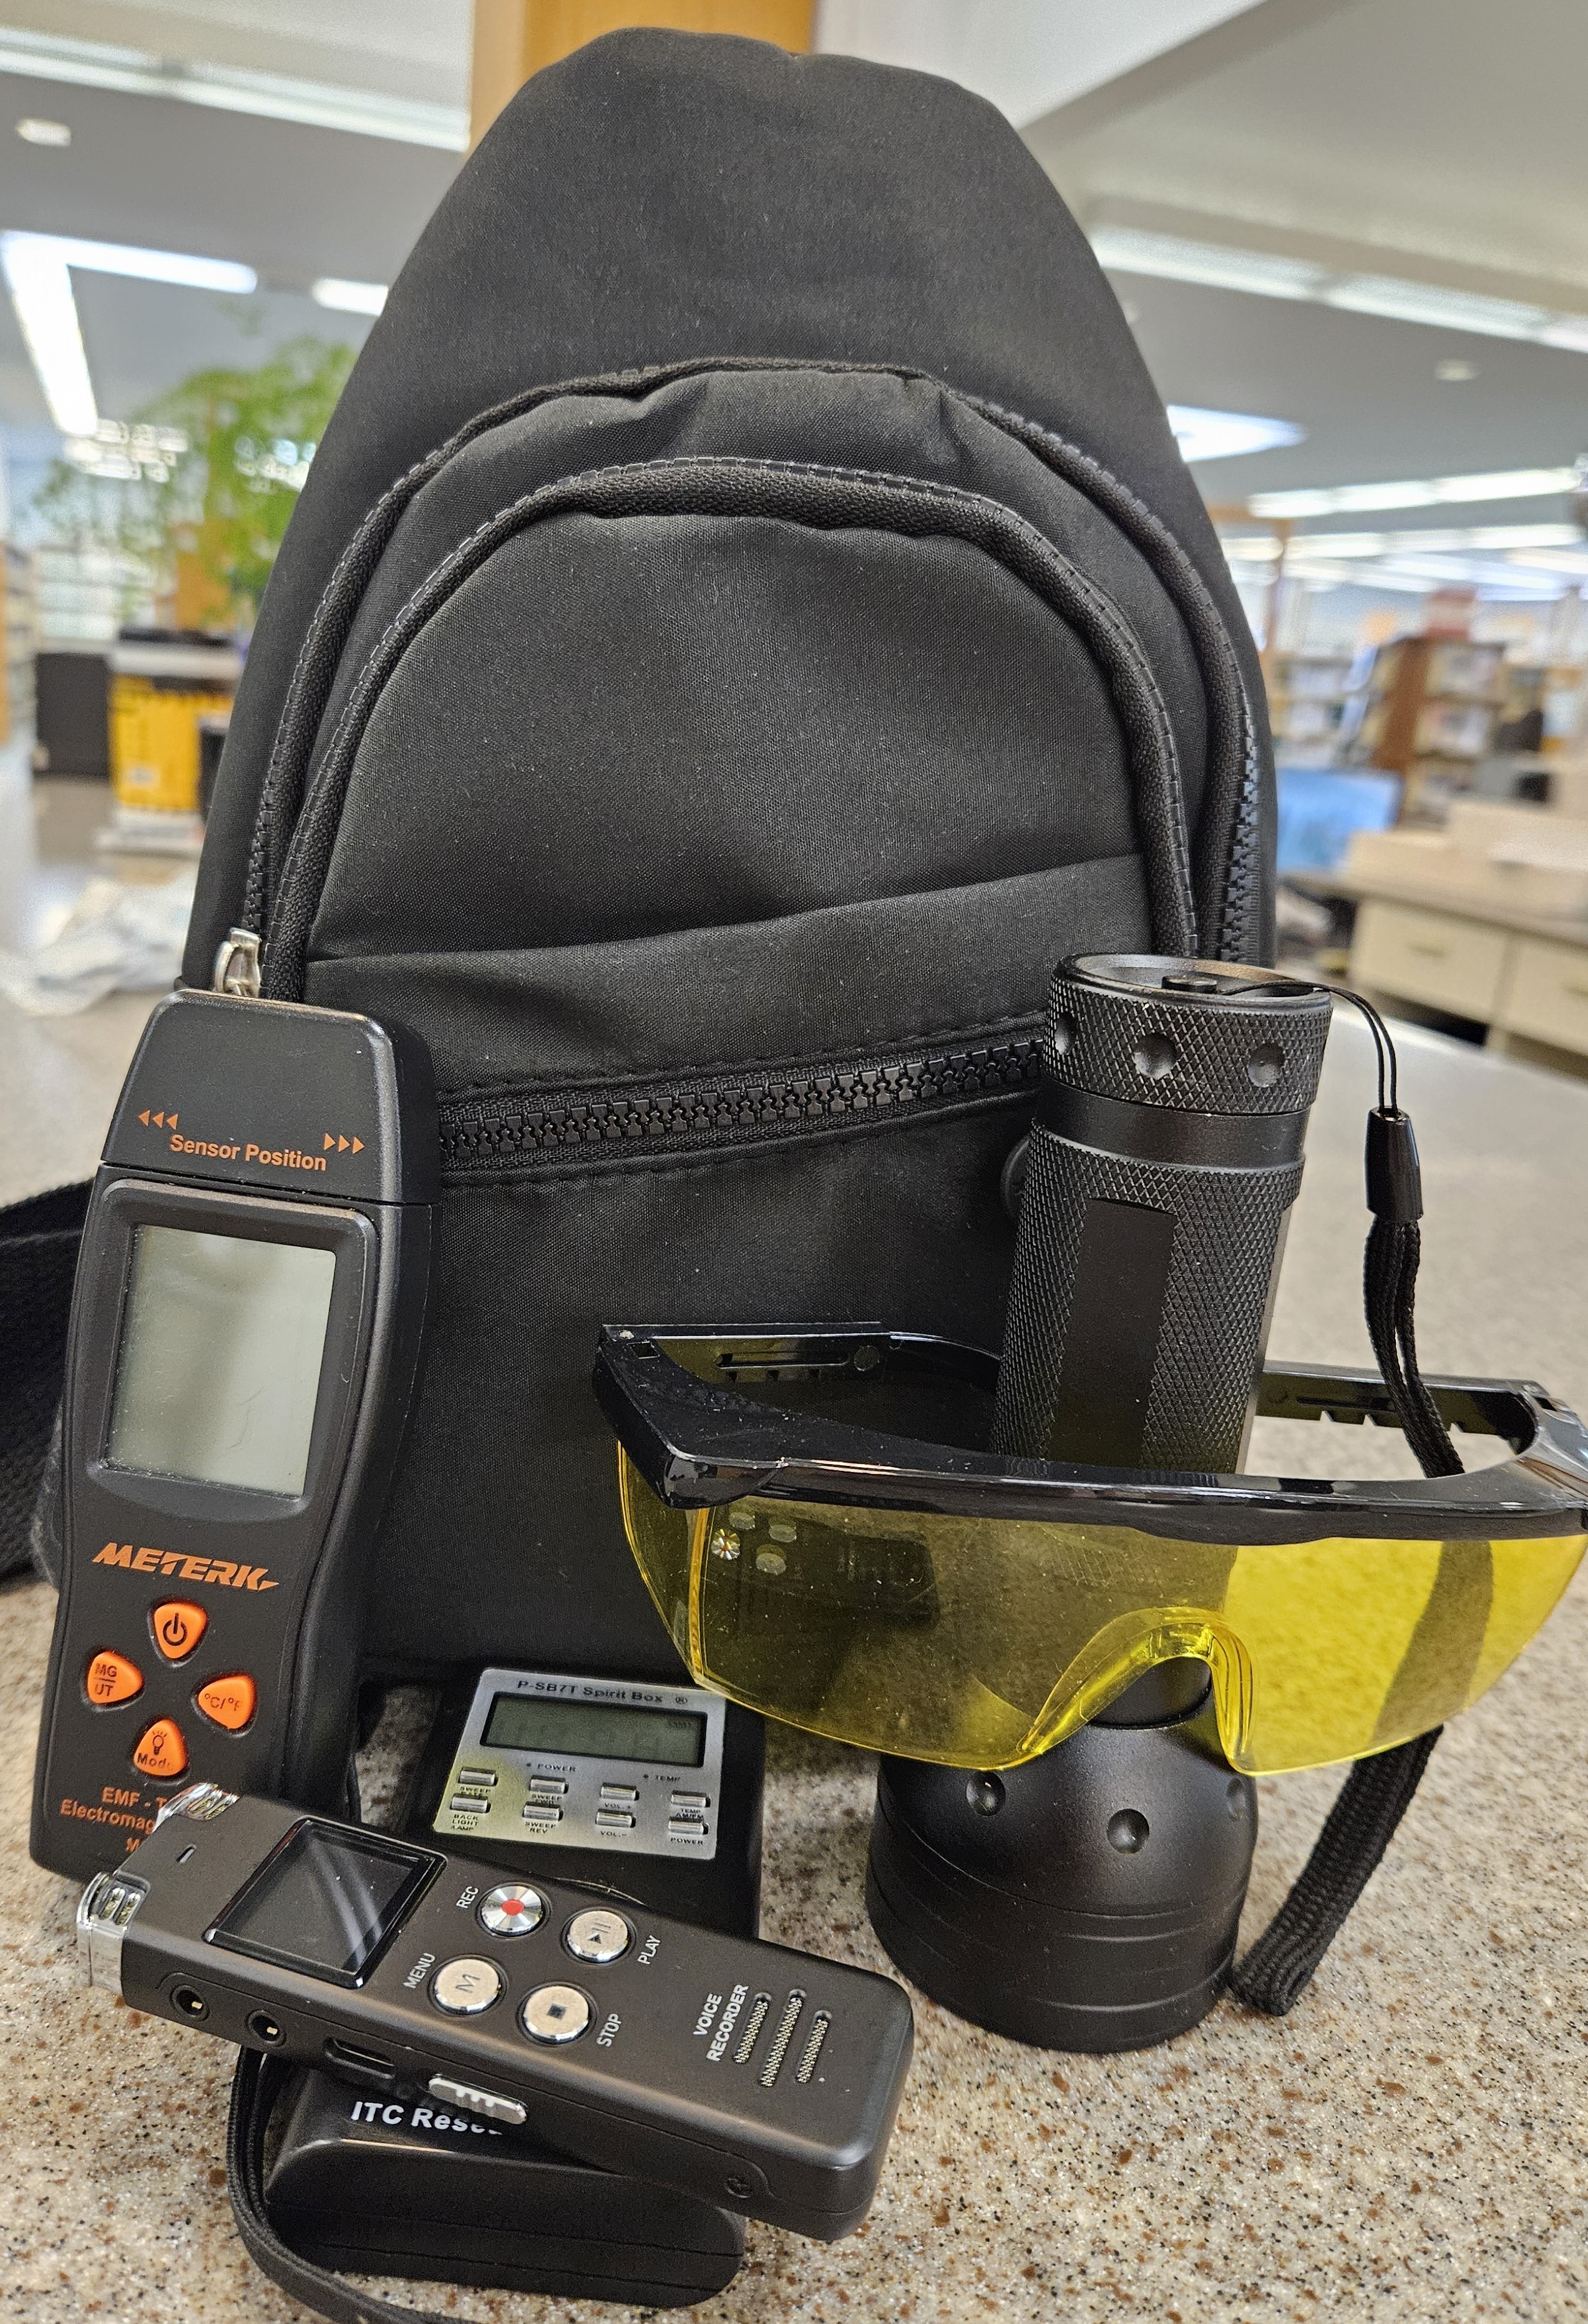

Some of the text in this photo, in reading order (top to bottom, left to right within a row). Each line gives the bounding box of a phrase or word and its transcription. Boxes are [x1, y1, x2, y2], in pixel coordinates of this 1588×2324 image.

[169, 1134, 327, 1171] Sensor Position
[92, 1542, 279, 1591] METERK
[95, 1663, 117, 1677] MG
[95, 1683, 114, 1697] UT
[583, 1687, 626, 1699] Spirit
[631, 1692, 663, 1702] Box
[537, 1763, 577, 1772] POWER
[655, 1775, 681, 1783] TEMP
[102, 1787, 140, 1807] EMF
[60, 1798, 155, 1835] Electromag
[670, 1837, 704, 1845] POWER
[455, 1886, 479, 1908] REC
[637, 1935, 661, 1965] PLAY
[402, 1953, 436, 1988] MENU
[455, 1973, 480, 1994] M
[693, 1993, 723, 2036] VOICE
[706, 1984, 749, 2061] RECORDER
[597, 2013, 622, 2047] STOP
[350, 2101, 405, 2124] ITC
